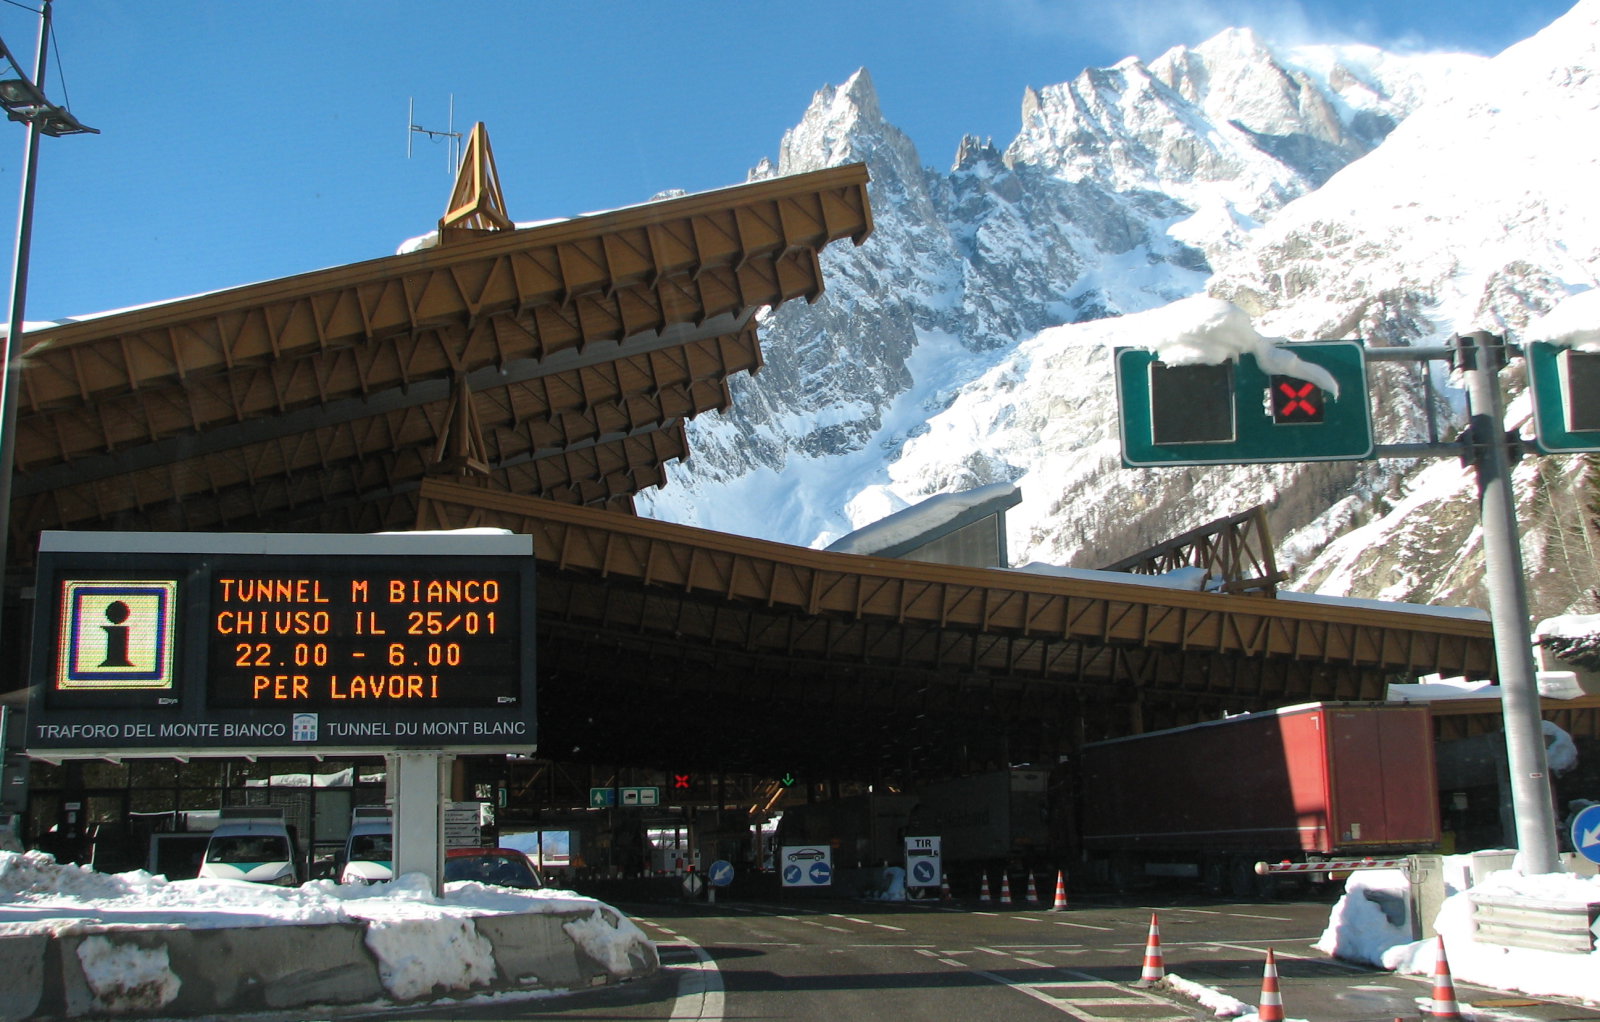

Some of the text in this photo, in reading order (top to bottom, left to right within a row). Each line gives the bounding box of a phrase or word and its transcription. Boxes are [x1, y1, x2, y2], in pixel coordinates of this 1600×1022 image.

[220, 579, 499, 603] TUNNEL M BIANCO
[218, 611, 496, 635] CHIUSO IL 25/01
[235, 643, 328, 667] 22.00
[388, 643, 460, 667] 6.00
[253, 674, 438, 700] PER LAVORI
[37, 723, 286, 738] TRAFORO DEL MONTE BIANCO
[293, 731, 317, 741] TMB
[327, 721, 526, 736] TUNNEL DU MONT BLANC
[914, 839, 932, 848] TIR
